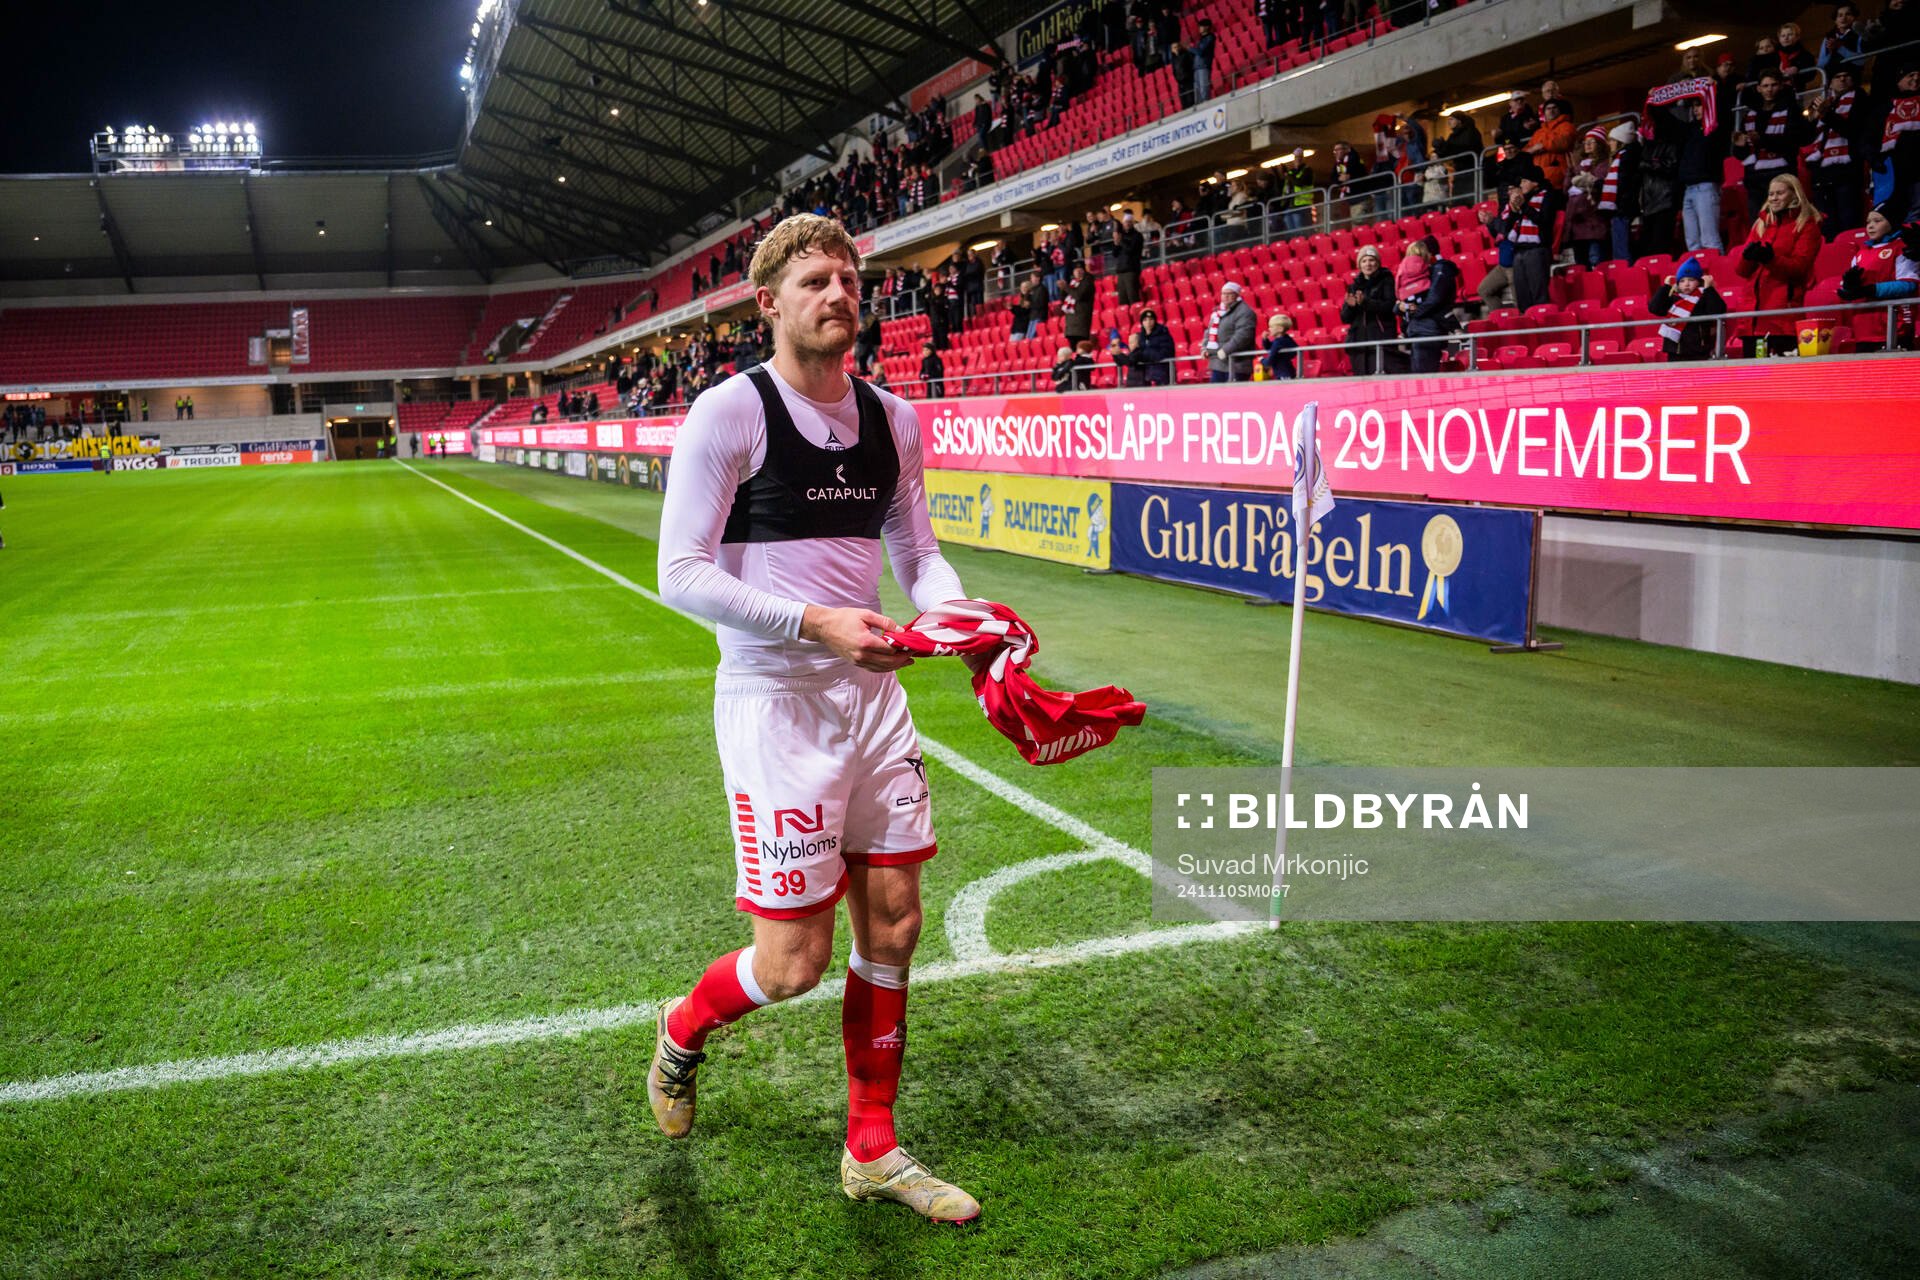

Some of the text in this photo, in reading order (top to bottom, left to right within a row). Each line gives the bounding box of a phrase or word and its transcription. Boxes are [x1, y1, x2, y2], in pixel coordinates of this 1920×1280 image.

[1020, 0, 1106, 58] GuldFåg
[1127, 143, 1141, 158] ETT
[1172, 119, 1208, 141] INTRYCK
[260, 451, 293, 463] renta
[932, 403, 1174, 462] SÄSONGSKORTSSLÄPP
[1334, 408, 1386, 471] 29
[1400, 405, 1752, 484] NOVEMBER
[114, 457, 158, 471] BYGG
[184, 456, 238, 466] TREBOLIT
[806, 488, 877, 500] CATAPULT
[929, 492, 974, 523] MIRENT
[1004, 498, 1080, 539] RAMIRENT
[1141, 495, 1415, 602] GuldFågeln
[762, 836, 837, 865] Nybloms
[771, 869, 806, 897] 39
